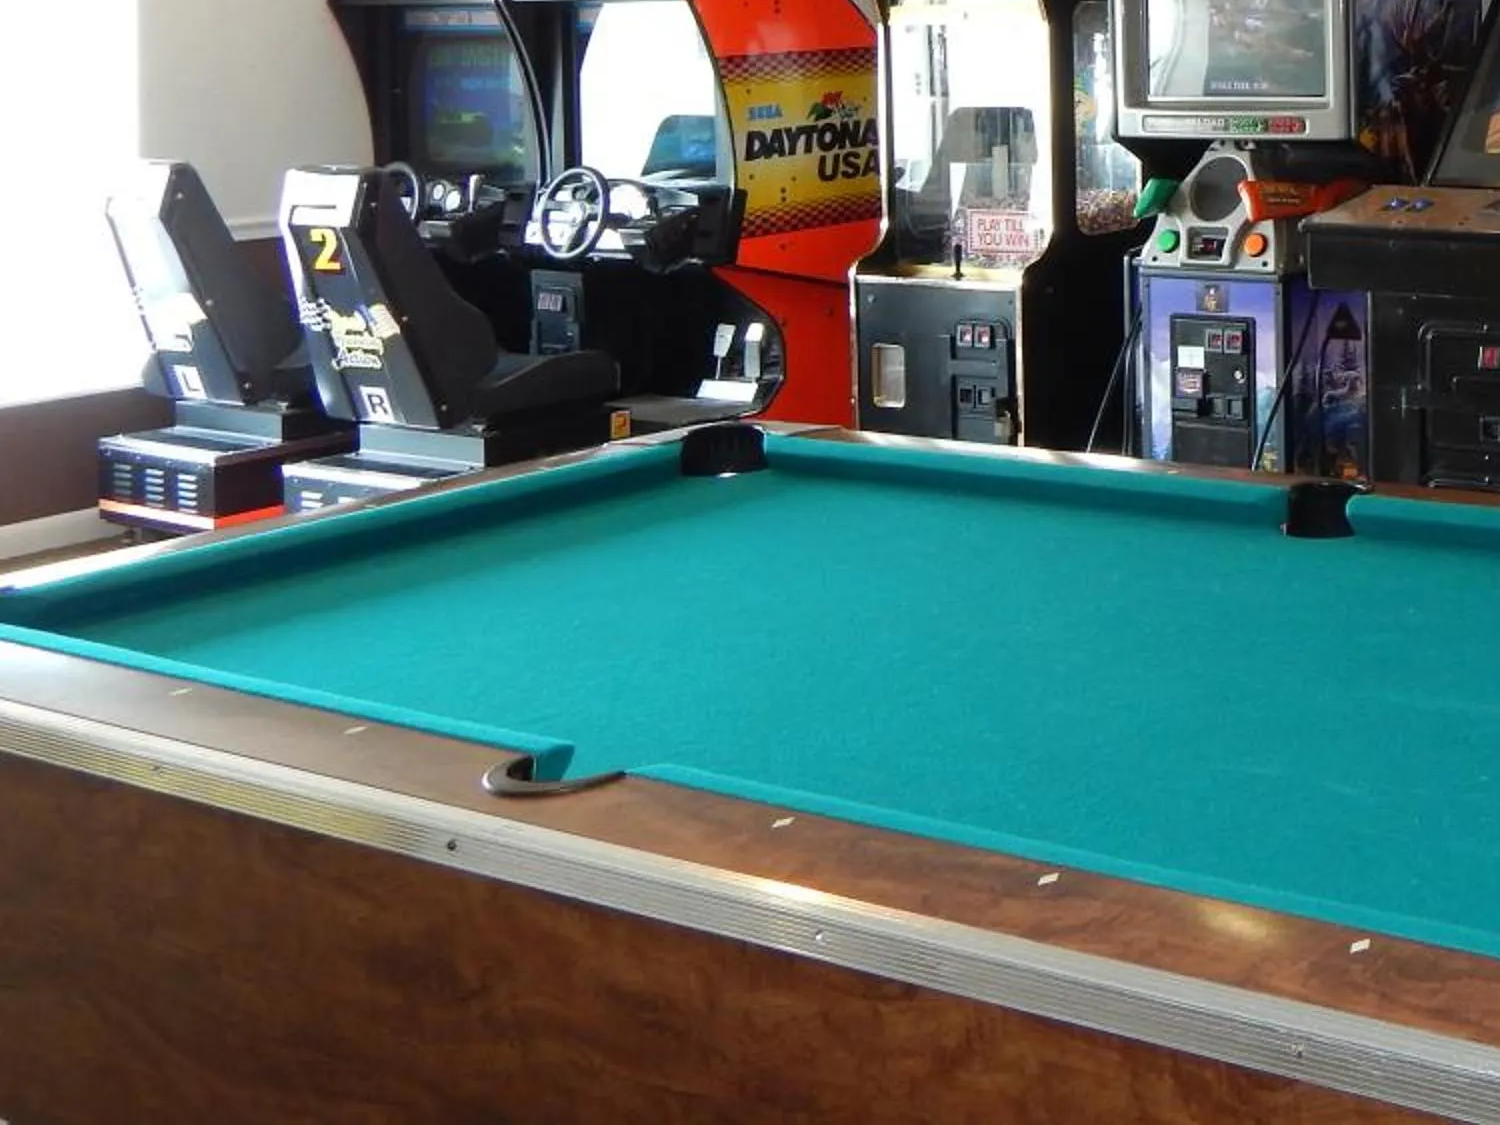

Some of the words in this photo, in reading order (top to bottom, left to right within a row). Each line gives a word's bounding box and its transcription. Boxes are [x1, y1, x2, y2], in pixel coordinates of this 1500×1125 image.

[744, 117, 880, 162] DAYTONA
[817, 149, 881, 182] USA
[309, 228, 342, 271] 2
[978, 232, 1003, 246] YOU
[180, 370, 202, 392] L
[367, 393, 389, 416] R
